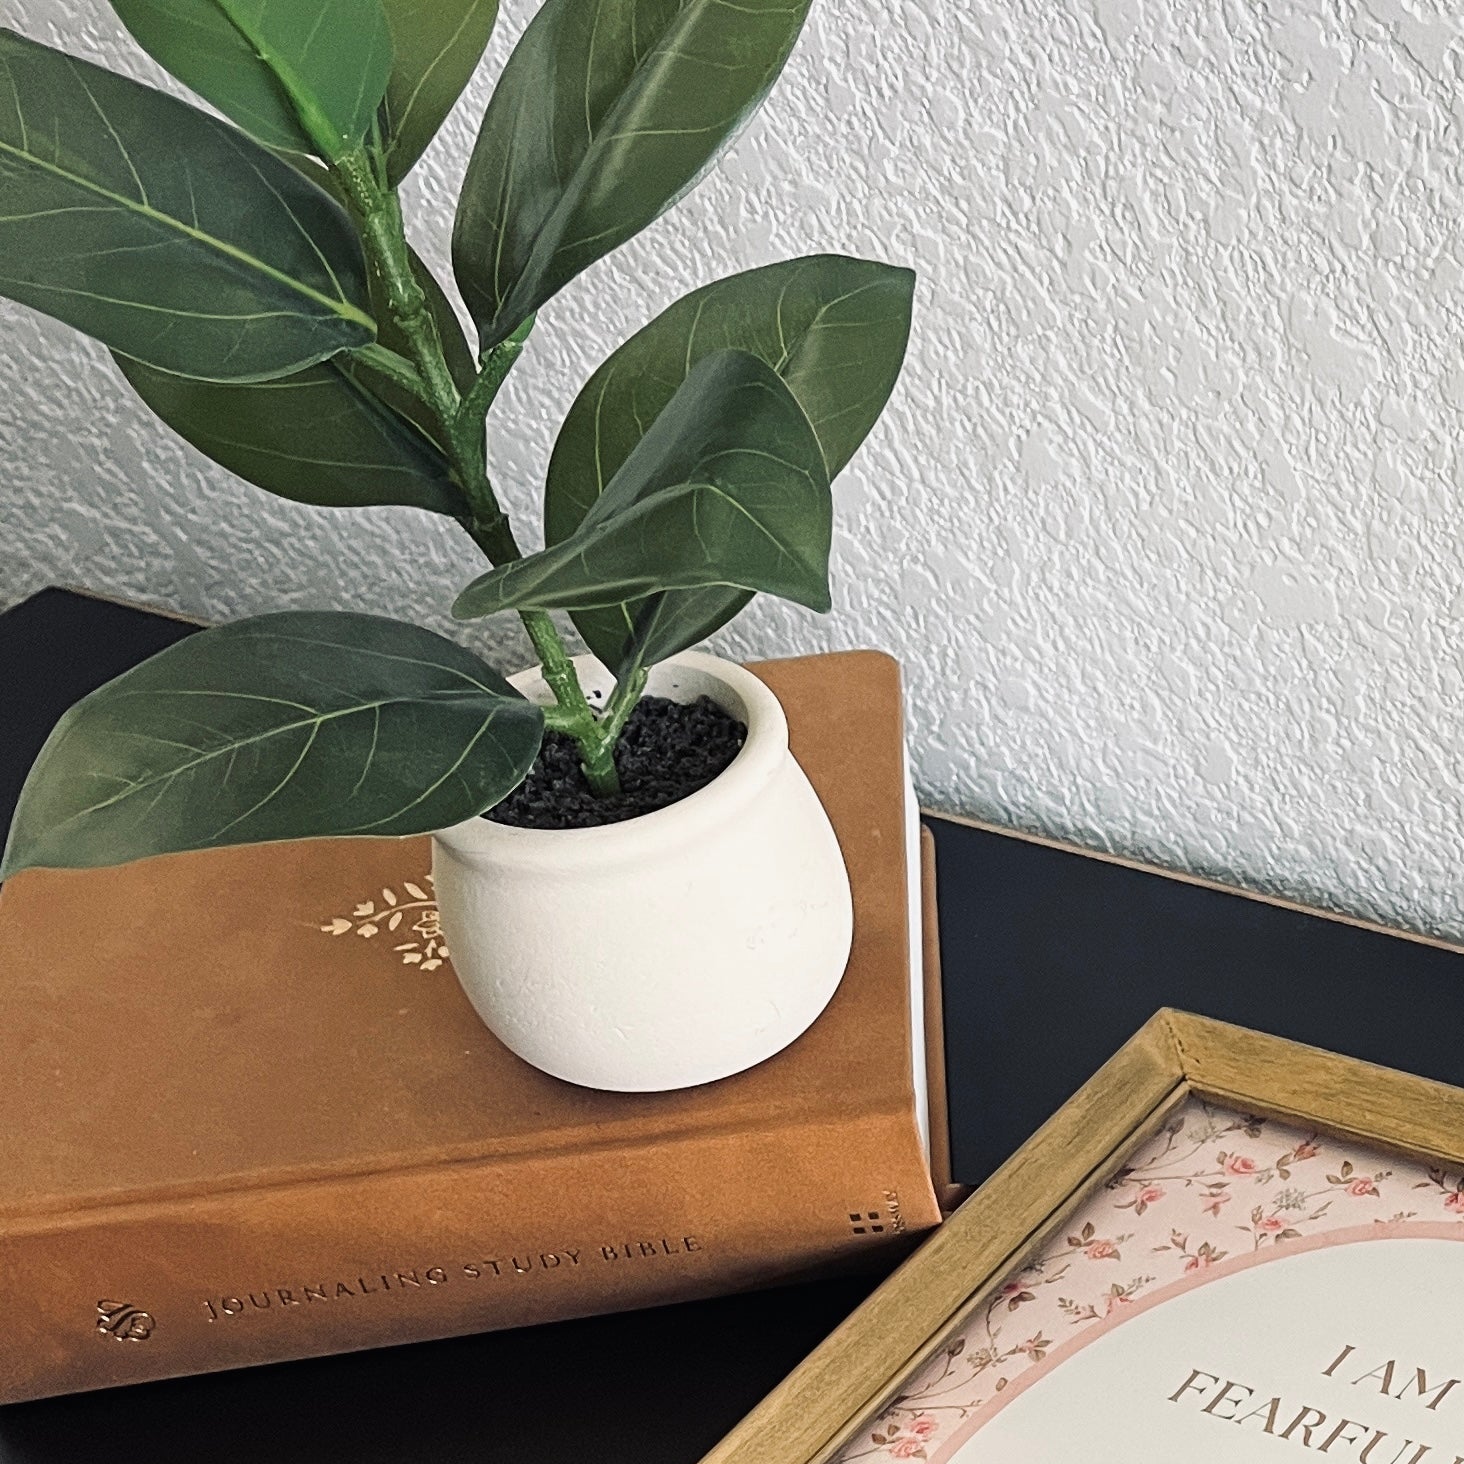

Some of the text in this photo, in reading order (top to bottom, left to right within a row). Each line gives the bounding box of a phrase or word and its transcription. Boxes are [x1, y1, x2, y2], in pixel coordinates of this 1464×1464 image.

[203, 1235, 702, 1323] JOURNALING STUDY BIBLE
[1321, 1344, 1462, 1411] I AM
